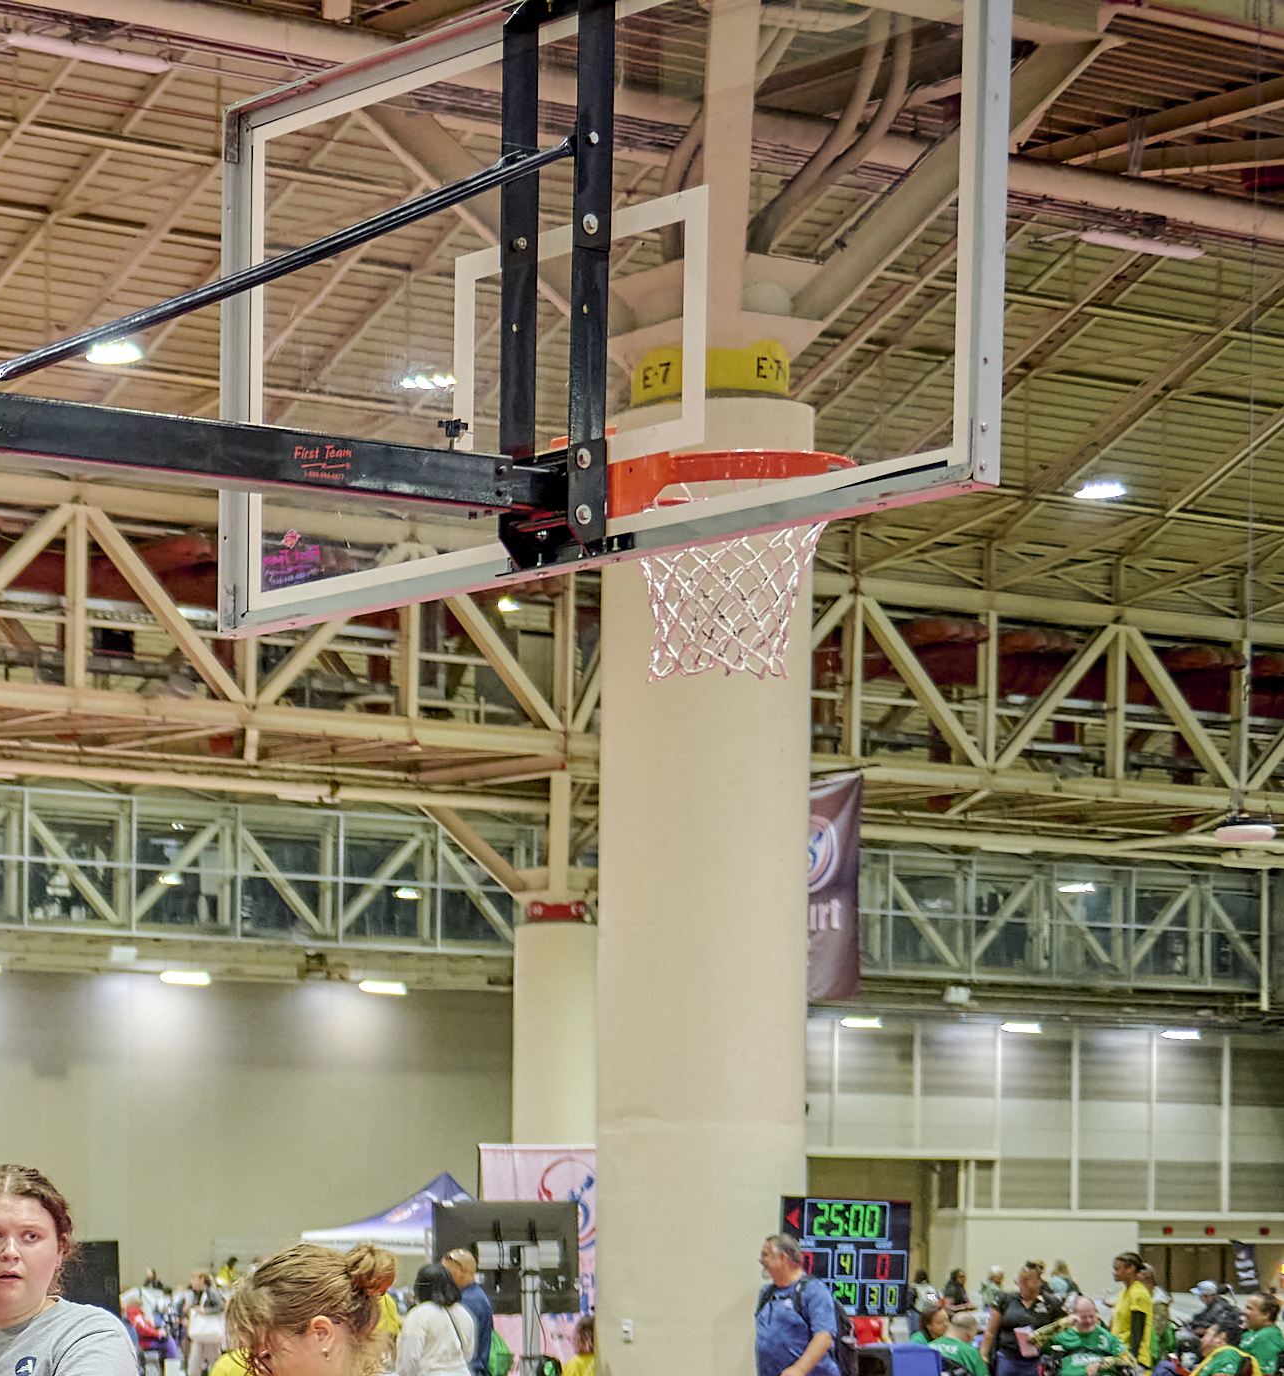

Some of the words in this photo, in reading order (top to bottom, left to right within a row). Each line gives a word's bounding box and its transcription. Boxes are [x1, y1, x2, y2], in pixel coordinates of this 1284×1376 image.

[293, 445, 320, 460] First
[324, 444, 352, 460] Team
[812, 1202, 882, 1238] 25:00
[875, 1253, 890, 1280] 0
